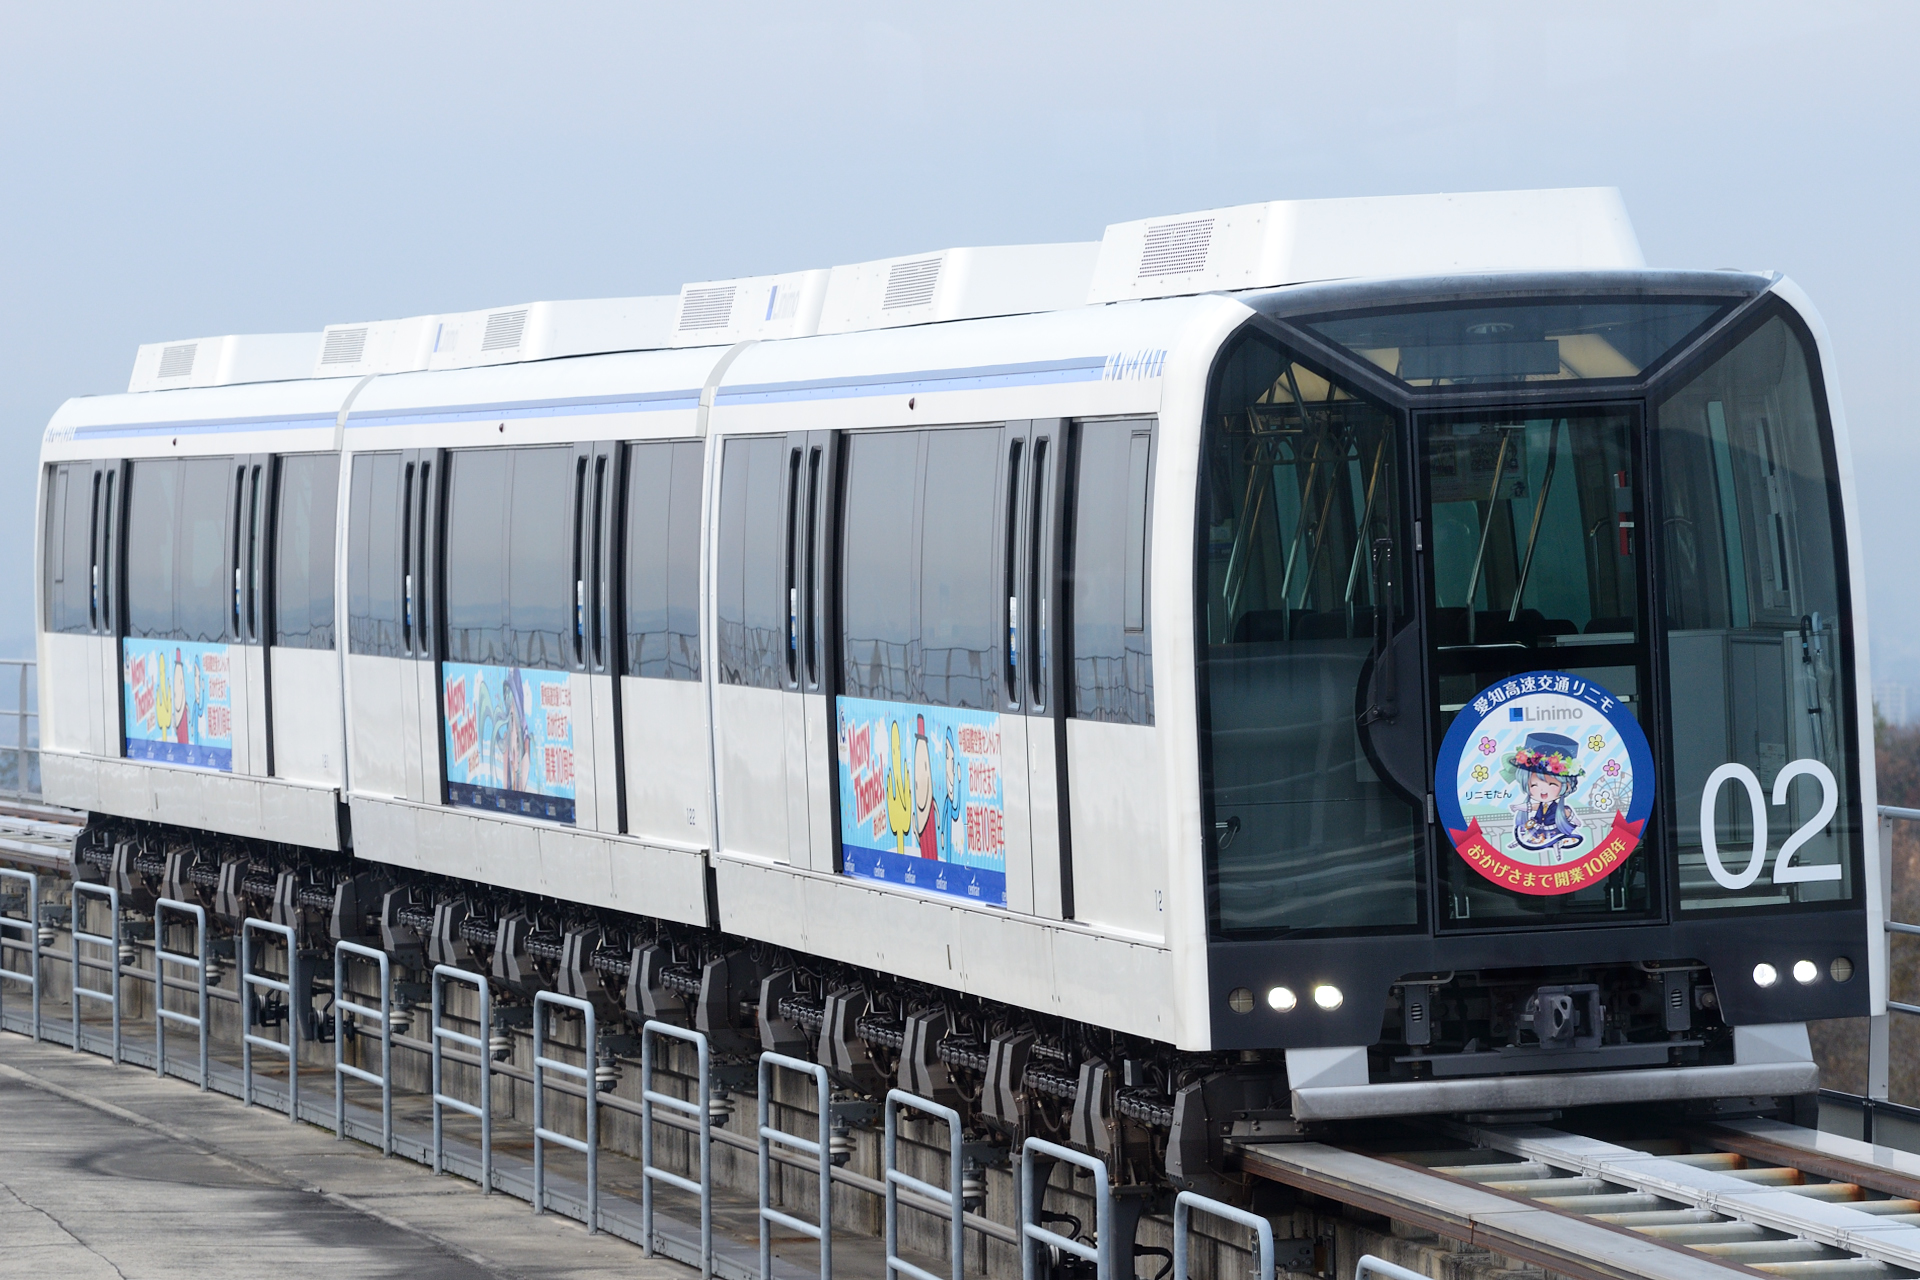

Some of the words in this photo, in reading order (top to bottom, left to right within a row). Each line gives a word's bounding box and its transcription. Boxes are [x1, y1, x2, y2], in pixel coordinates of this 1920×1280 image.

[446, 677, 466, 721] Many
[1473, 675, 1615, 717] 愛知高速交通リニモ
[1525, 707, 1583, 721] Linimo
[848, 723, 870, 775] Many
[854, 753, 885, 824] Thanks!
[1465, 790, 1512, 800] リニモたん
[1701, 758, 1842, 890] 02
[1467, 837, 1627, 888] おかげさまで開業10周年
